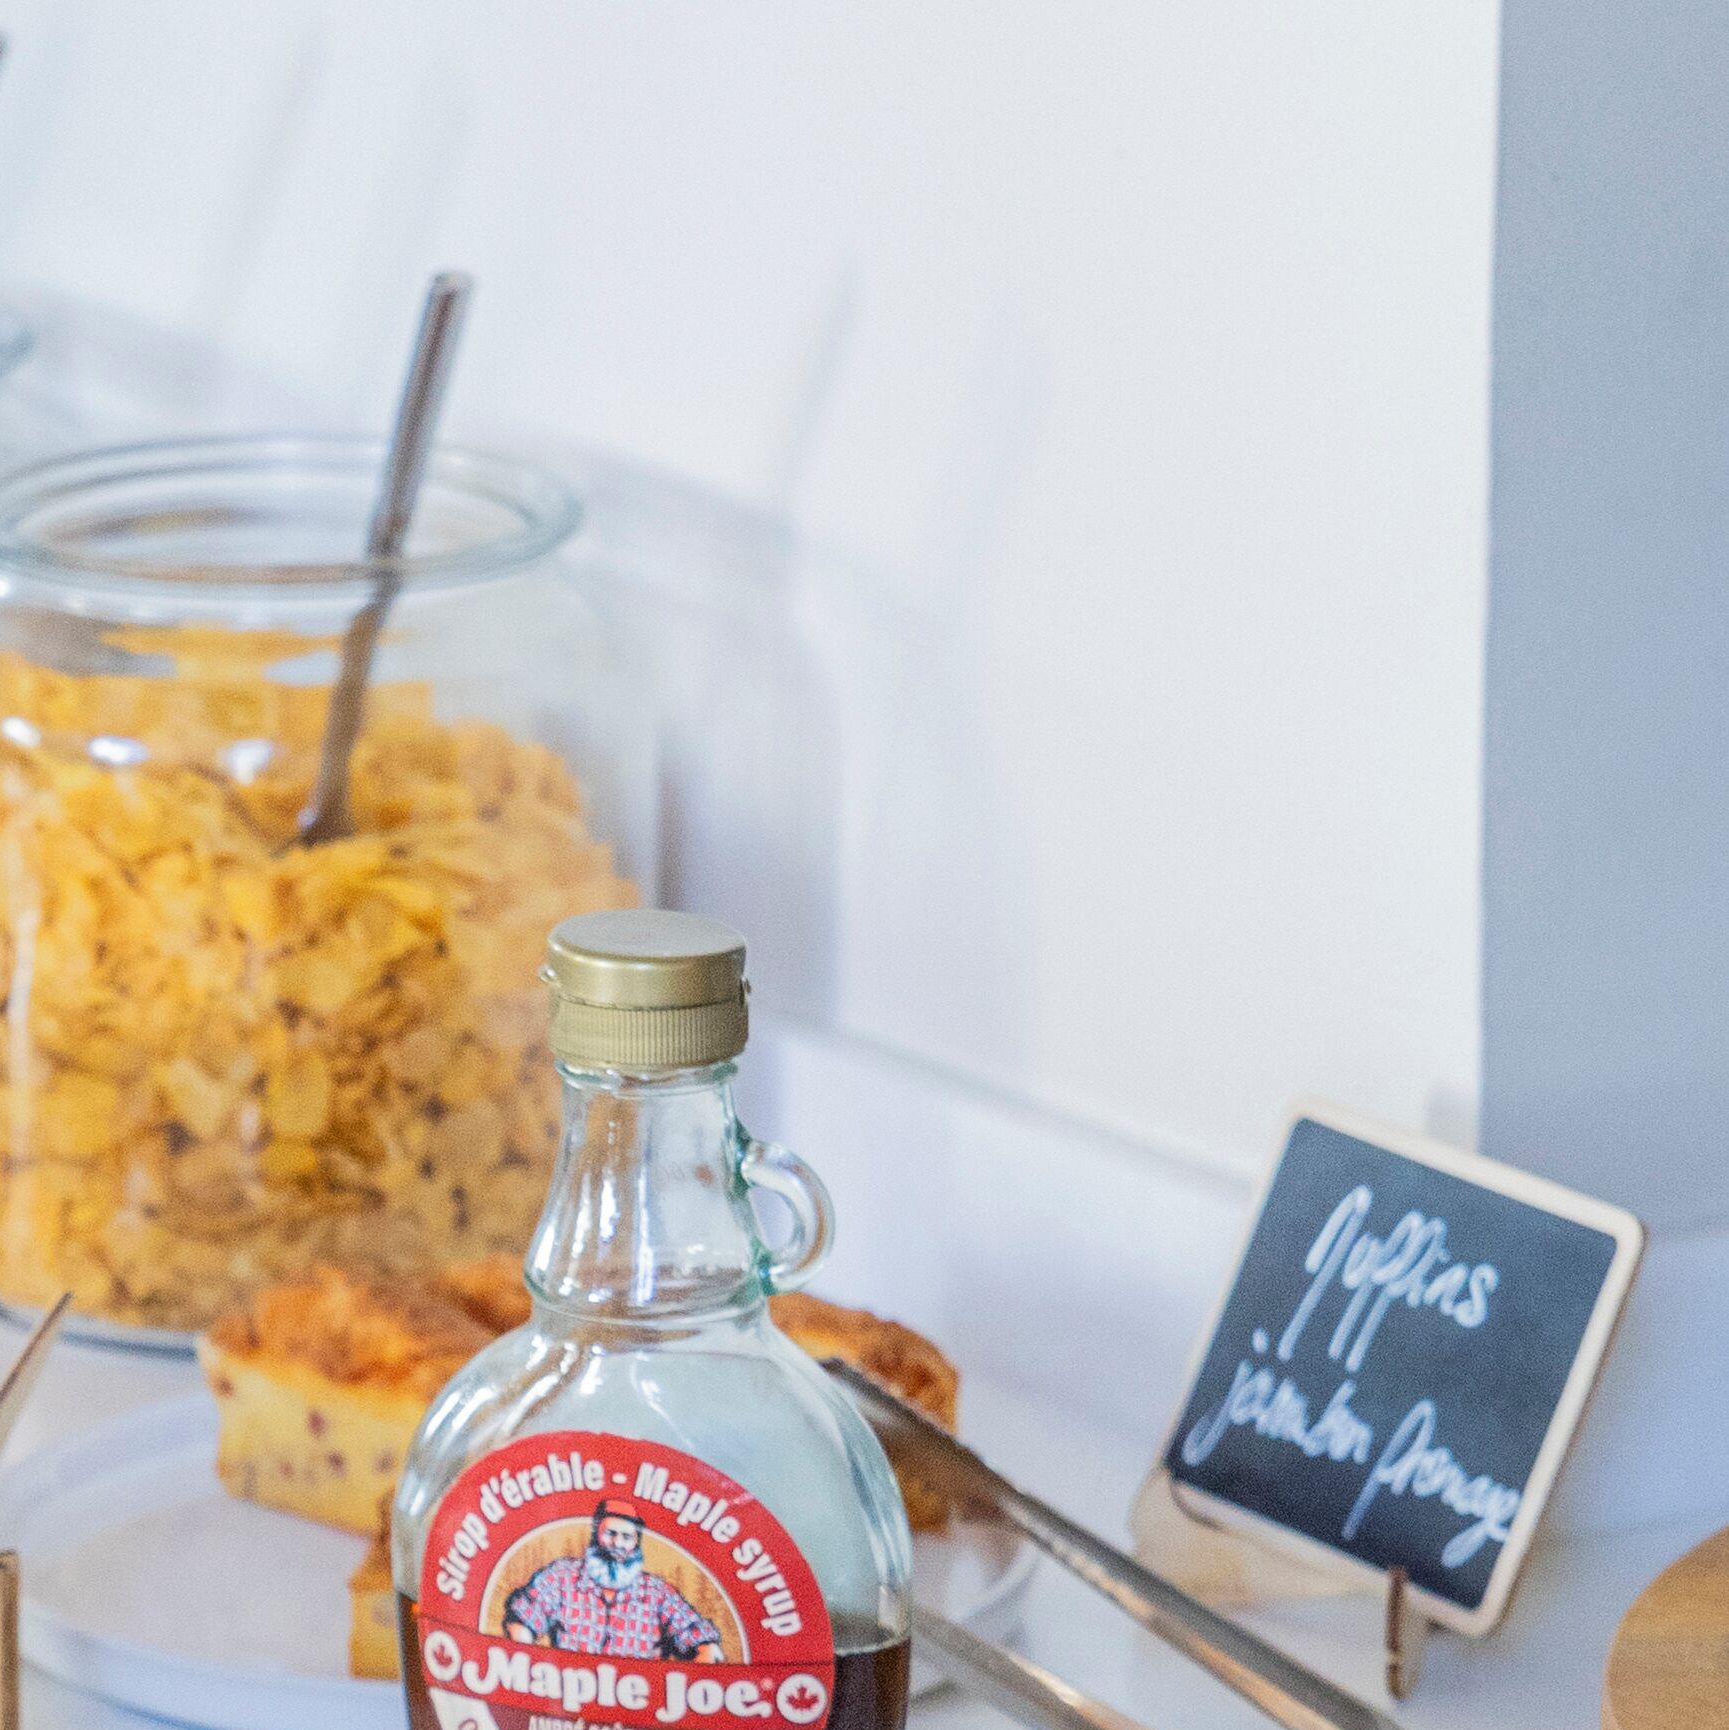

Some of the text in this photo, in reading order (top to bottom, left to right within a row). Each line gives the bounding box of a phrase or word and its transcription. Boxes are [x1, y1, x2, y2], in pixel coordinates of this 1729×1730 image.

[435, 1512, 492, 1601] Sirop
[479, 1450, 604, 1521] d'érable
[633, 1461, 741, 1543] Maple
[732, 1536, 803, 1637] syrup
[461, 1646, 772, 1723] Maple Joe
